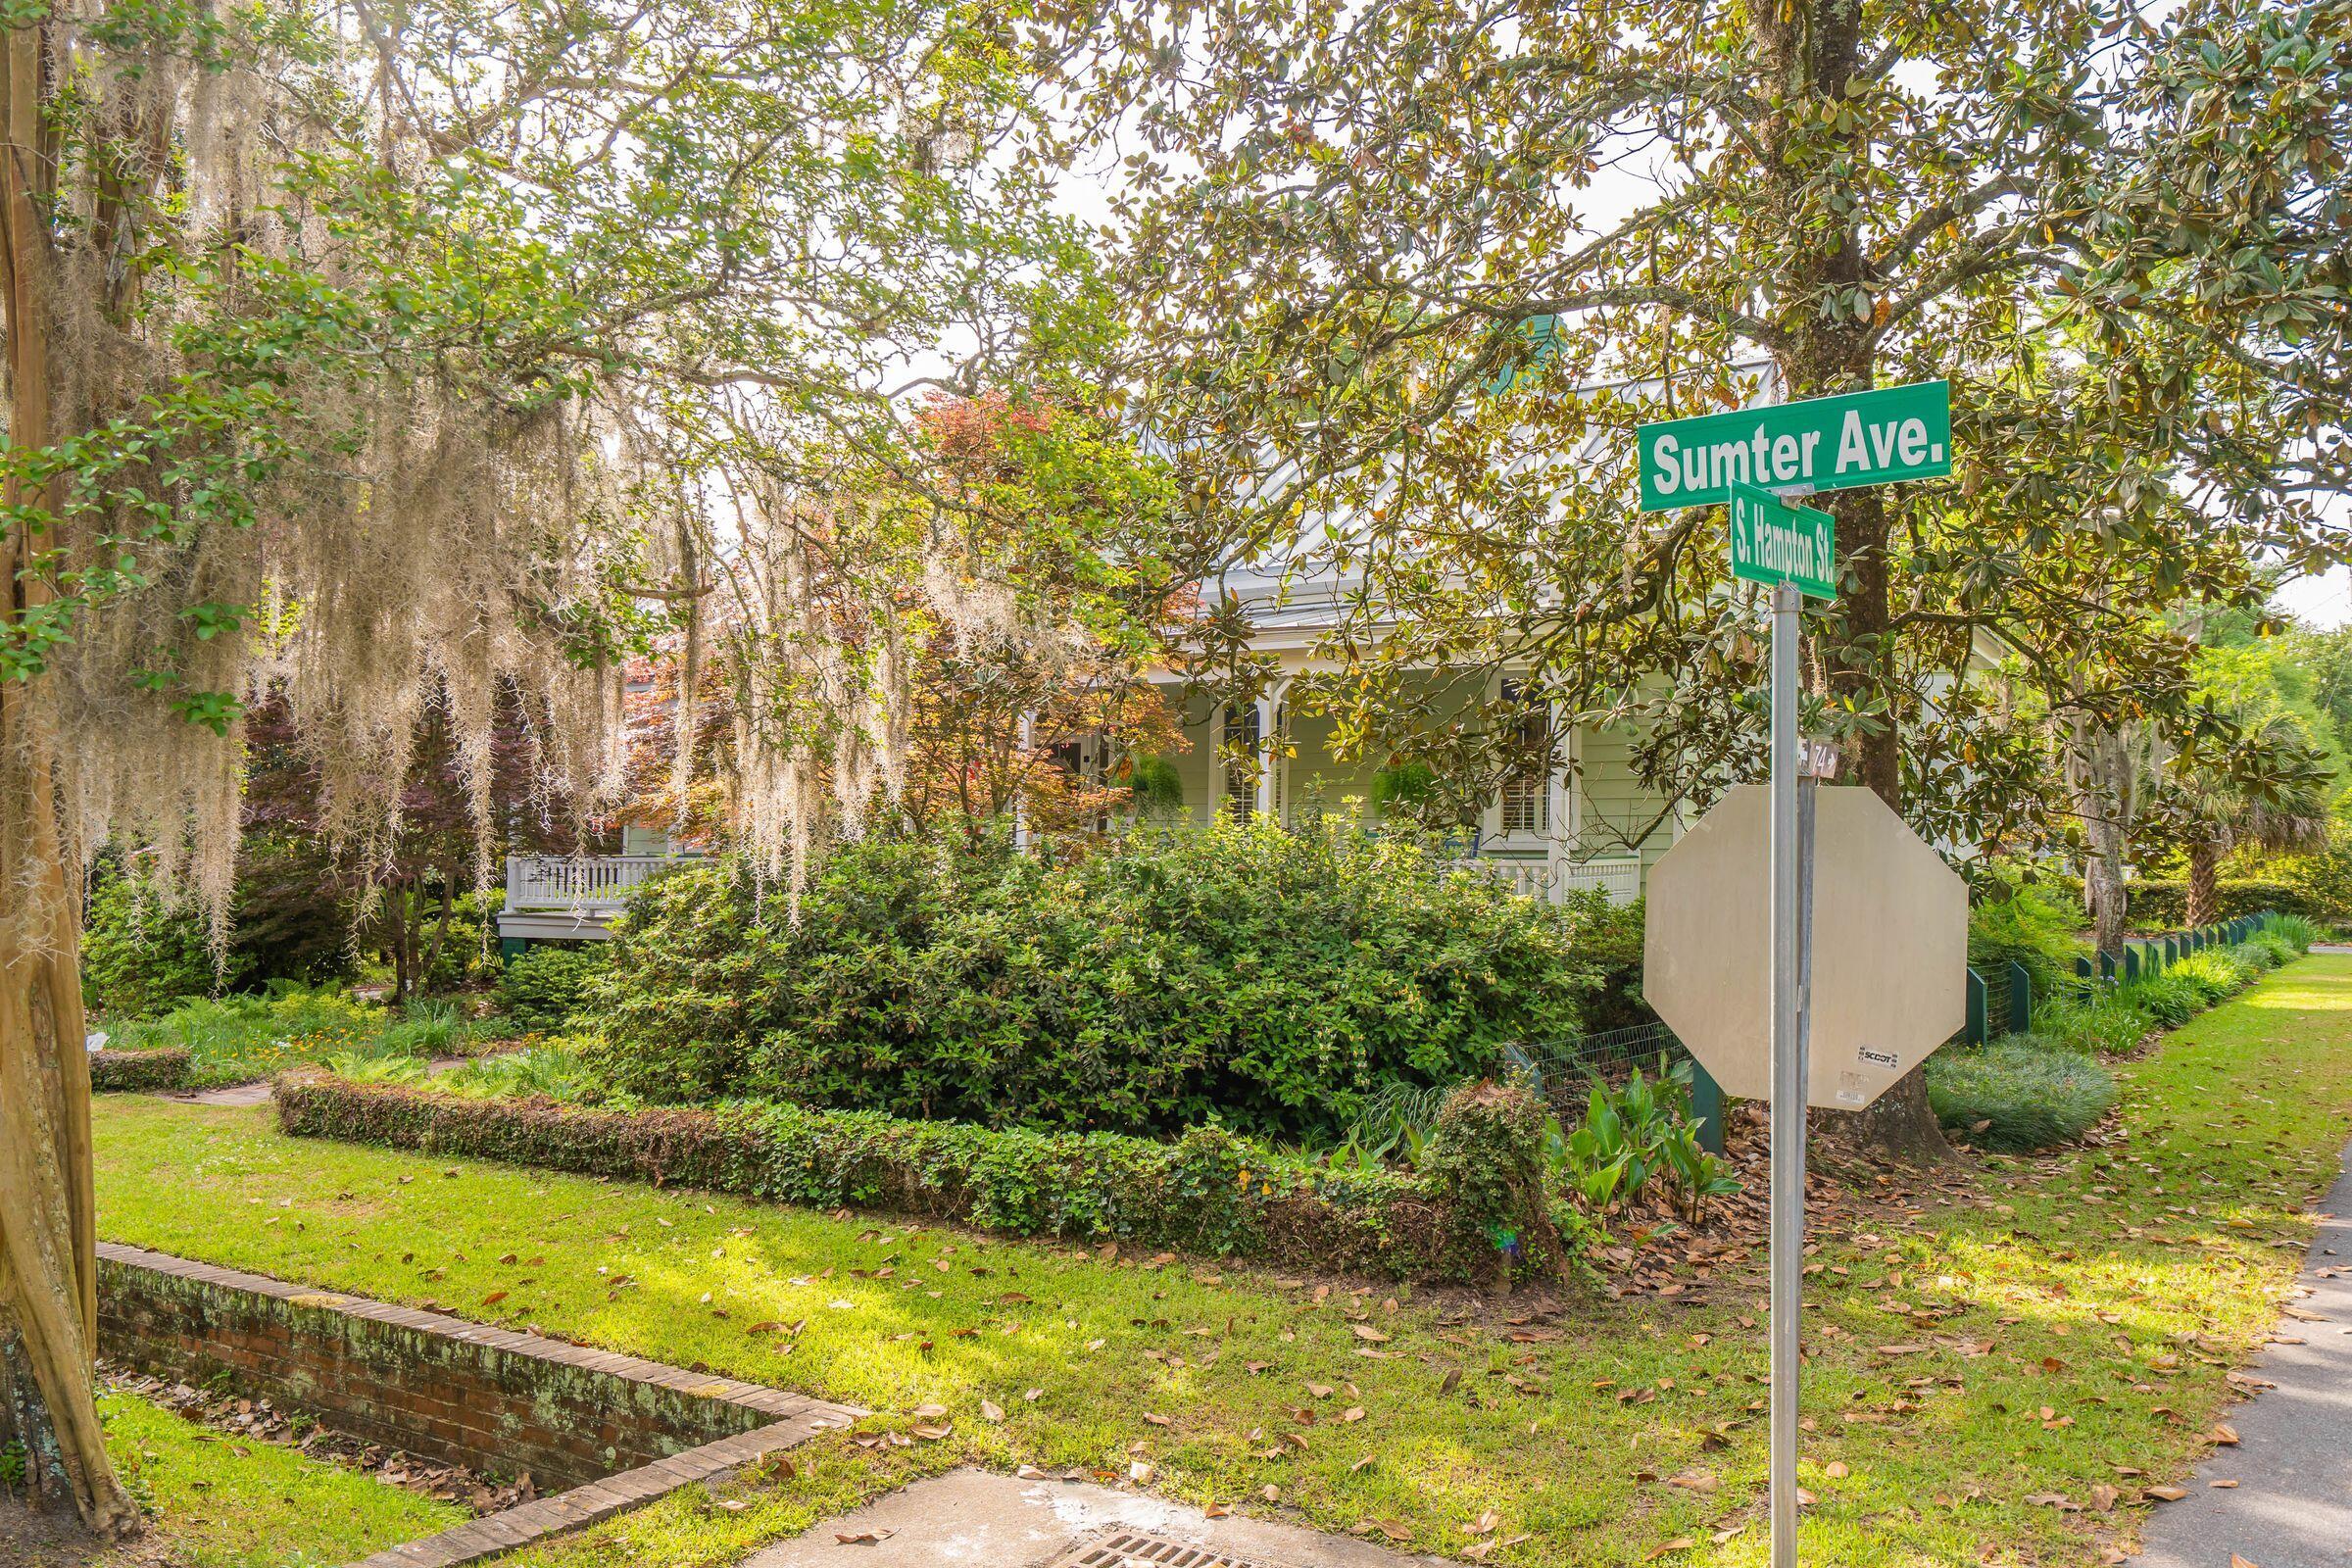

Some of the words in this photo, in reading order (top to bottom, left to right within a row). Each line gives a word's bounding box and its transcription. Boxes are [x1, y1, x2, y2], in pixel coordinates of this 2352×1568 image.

[1653, 422, 1820, 494] Sumter
[1836, 410, 1943, 474] Ave.
[1737, 497, 1751, 564] S.
[1754, 503, 1812, 580] Hampton
[1816, 522, 1834, 583] St.
